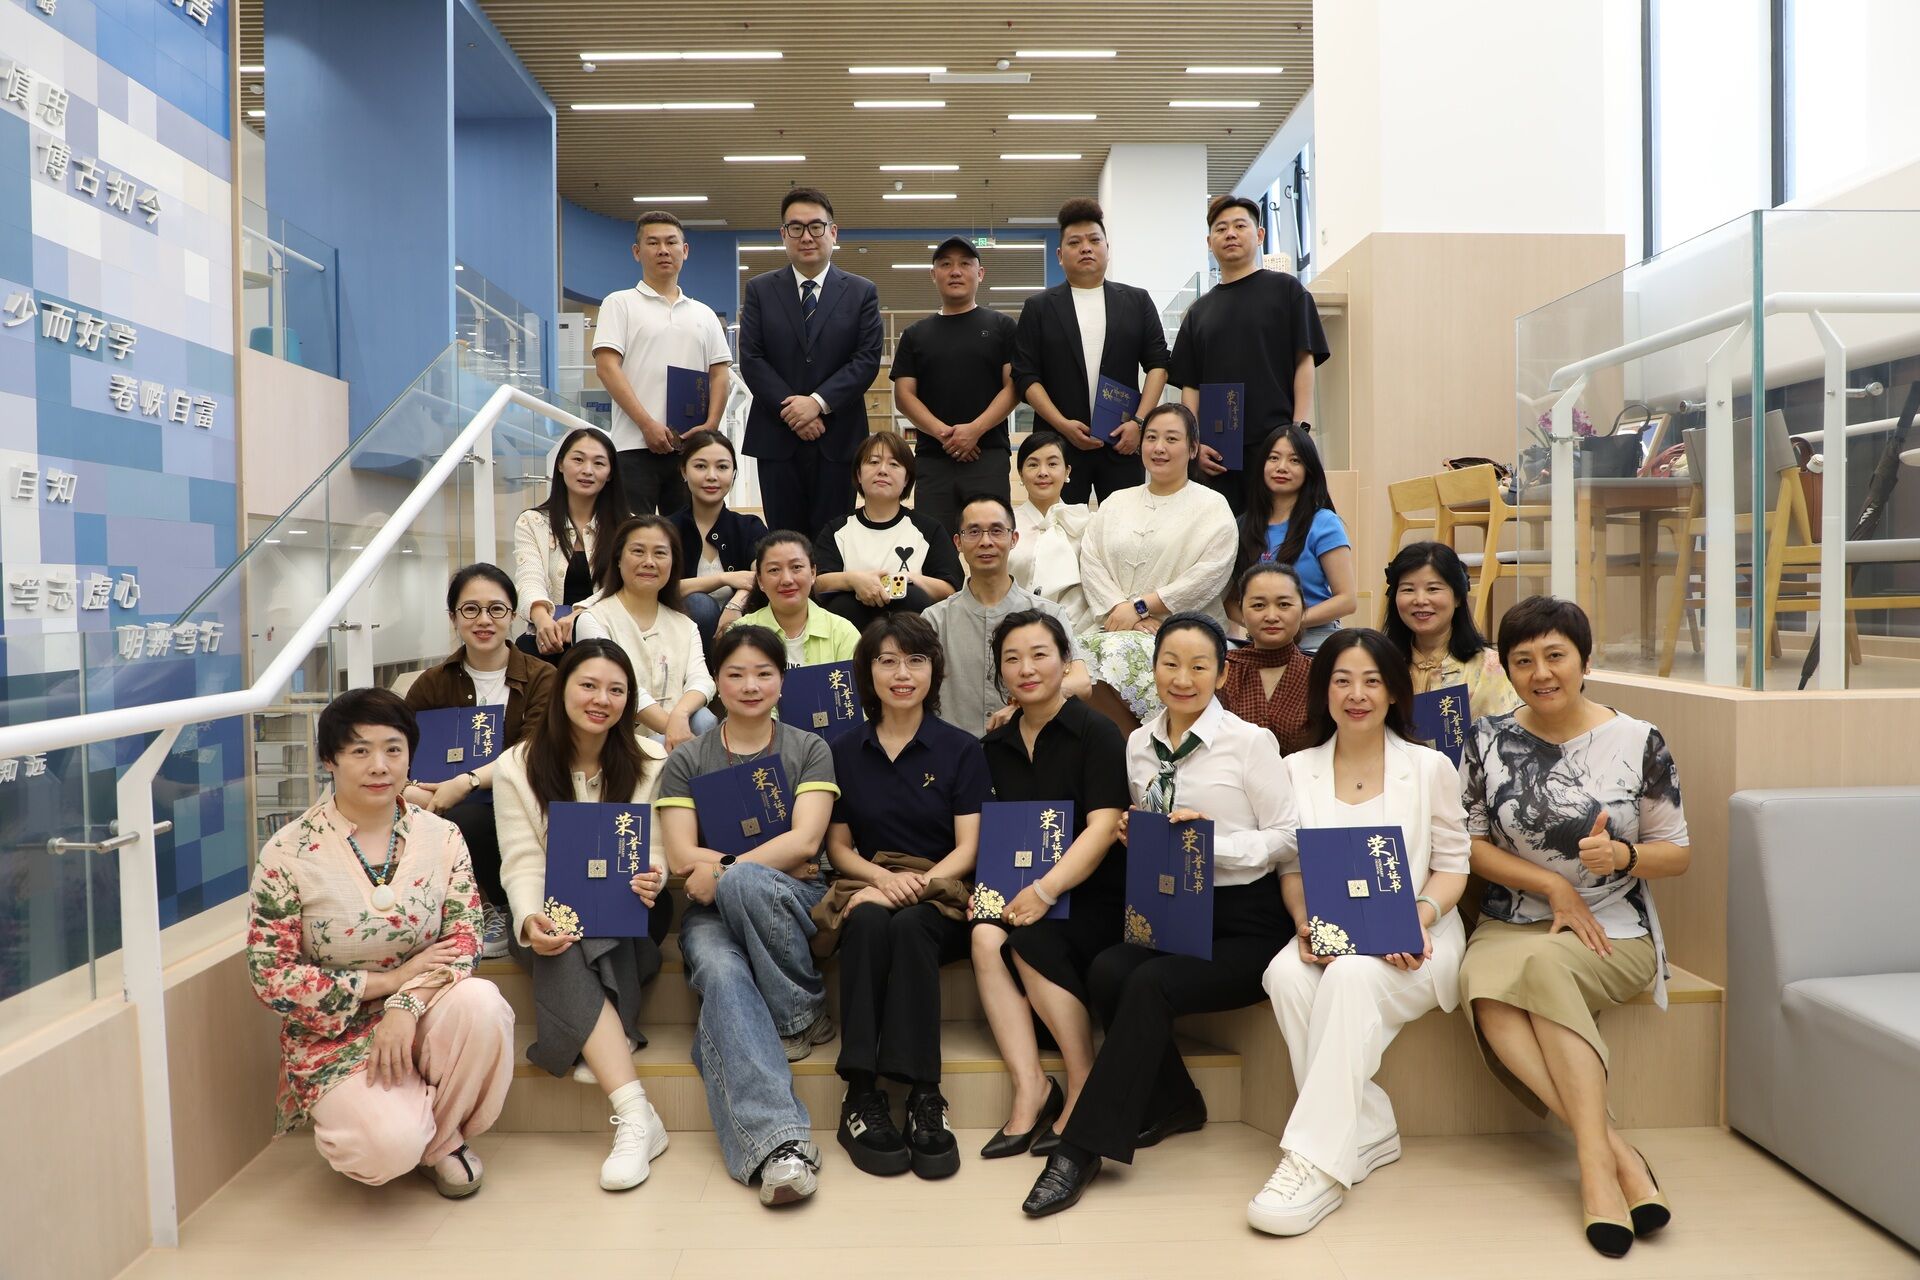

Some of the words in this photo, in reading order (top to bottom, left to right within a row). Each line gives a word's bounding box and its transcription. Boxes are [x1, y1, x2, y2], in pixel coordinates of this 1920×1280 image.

[37, 134, 161, 224] 博古知今
[4, 292, 138, 360] 少而好学
[109, 374, 217, 429] 卷帙自富
[10, 463, 78, 503] 自知
[116, 620, 224, 659] 明辨笃行
[828, 669, 854, 720] 荣誉证书
[1440, 696, 1463, 747] 荣誉证书
[471, 712, 495, 757] 荣誉证书
[752, 768, 787, 821] 荣誉证书
[615, 812, 642, 875] 荣誉证书
[1040, 808, 1065, 863] 荣誉证书
[1181, 827, 1206, 895] 荣誉证书
[1367, 834, 1402, 893] 荣誉证书
